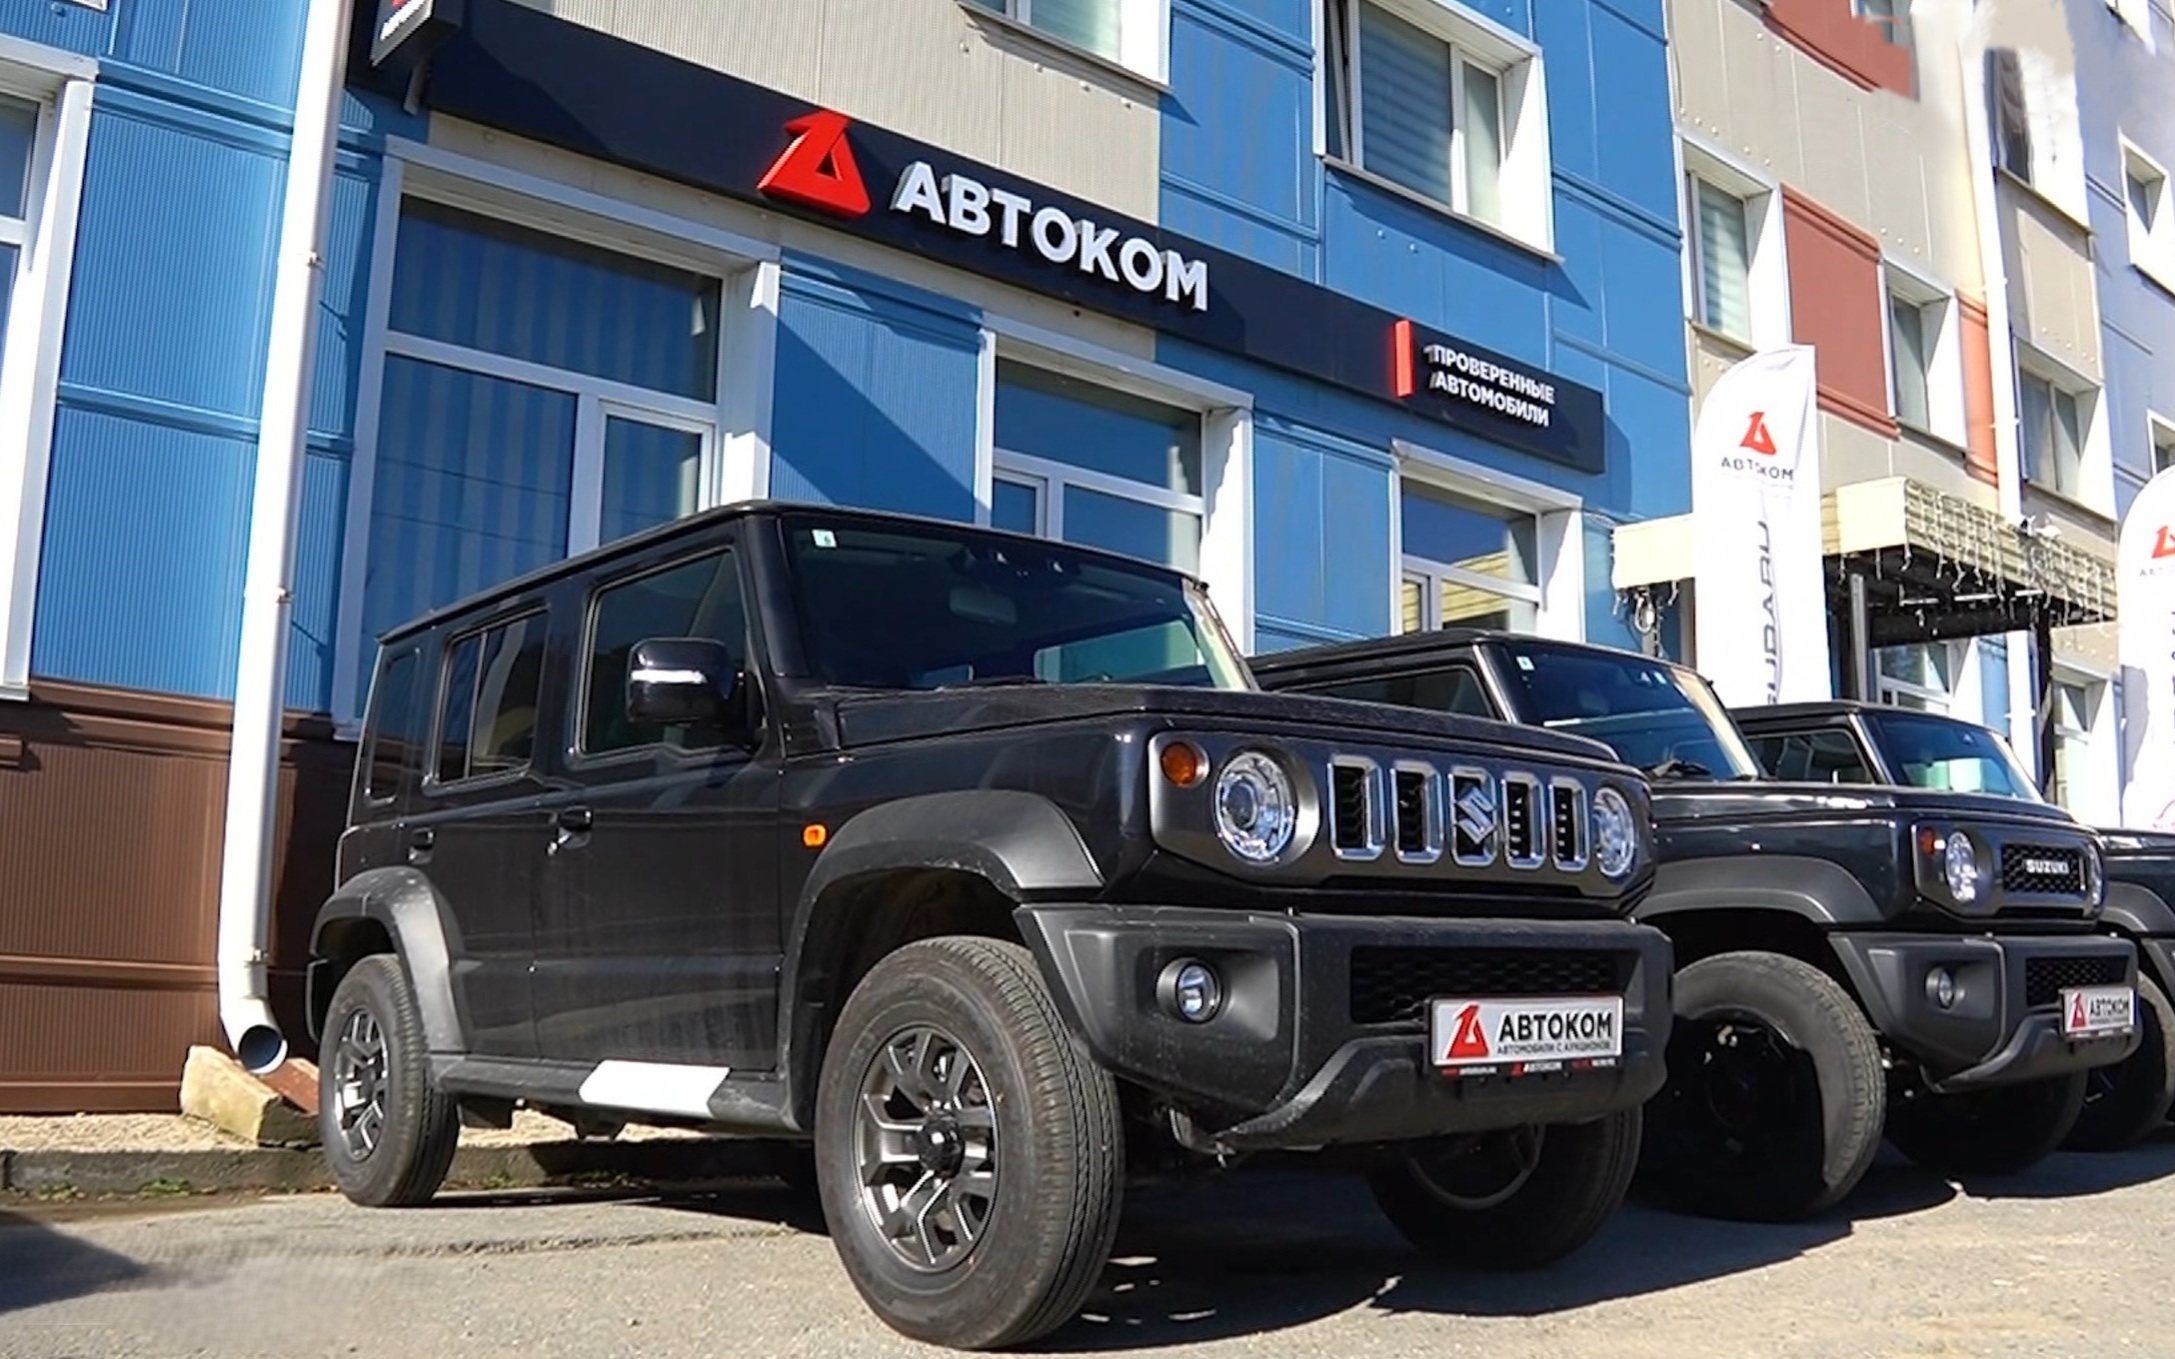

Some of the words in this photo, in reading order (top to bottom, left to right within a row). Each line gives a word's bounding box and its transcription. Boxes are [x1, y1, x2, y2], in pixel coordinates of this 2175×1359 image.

[891, 161, 1208, 311] АВТОКОМ
[1427, 344, 1555, 404] ПРОВЕРЕННЫЕ
[1432, 371, 1549, 427] АВТОМОБИЛИ
[2025, 859, 2070, 874] SUZUKI
[1499, 1012, 1612, 1041] АВТОКОМ
[1556, 1042, 1562, 1053] С
